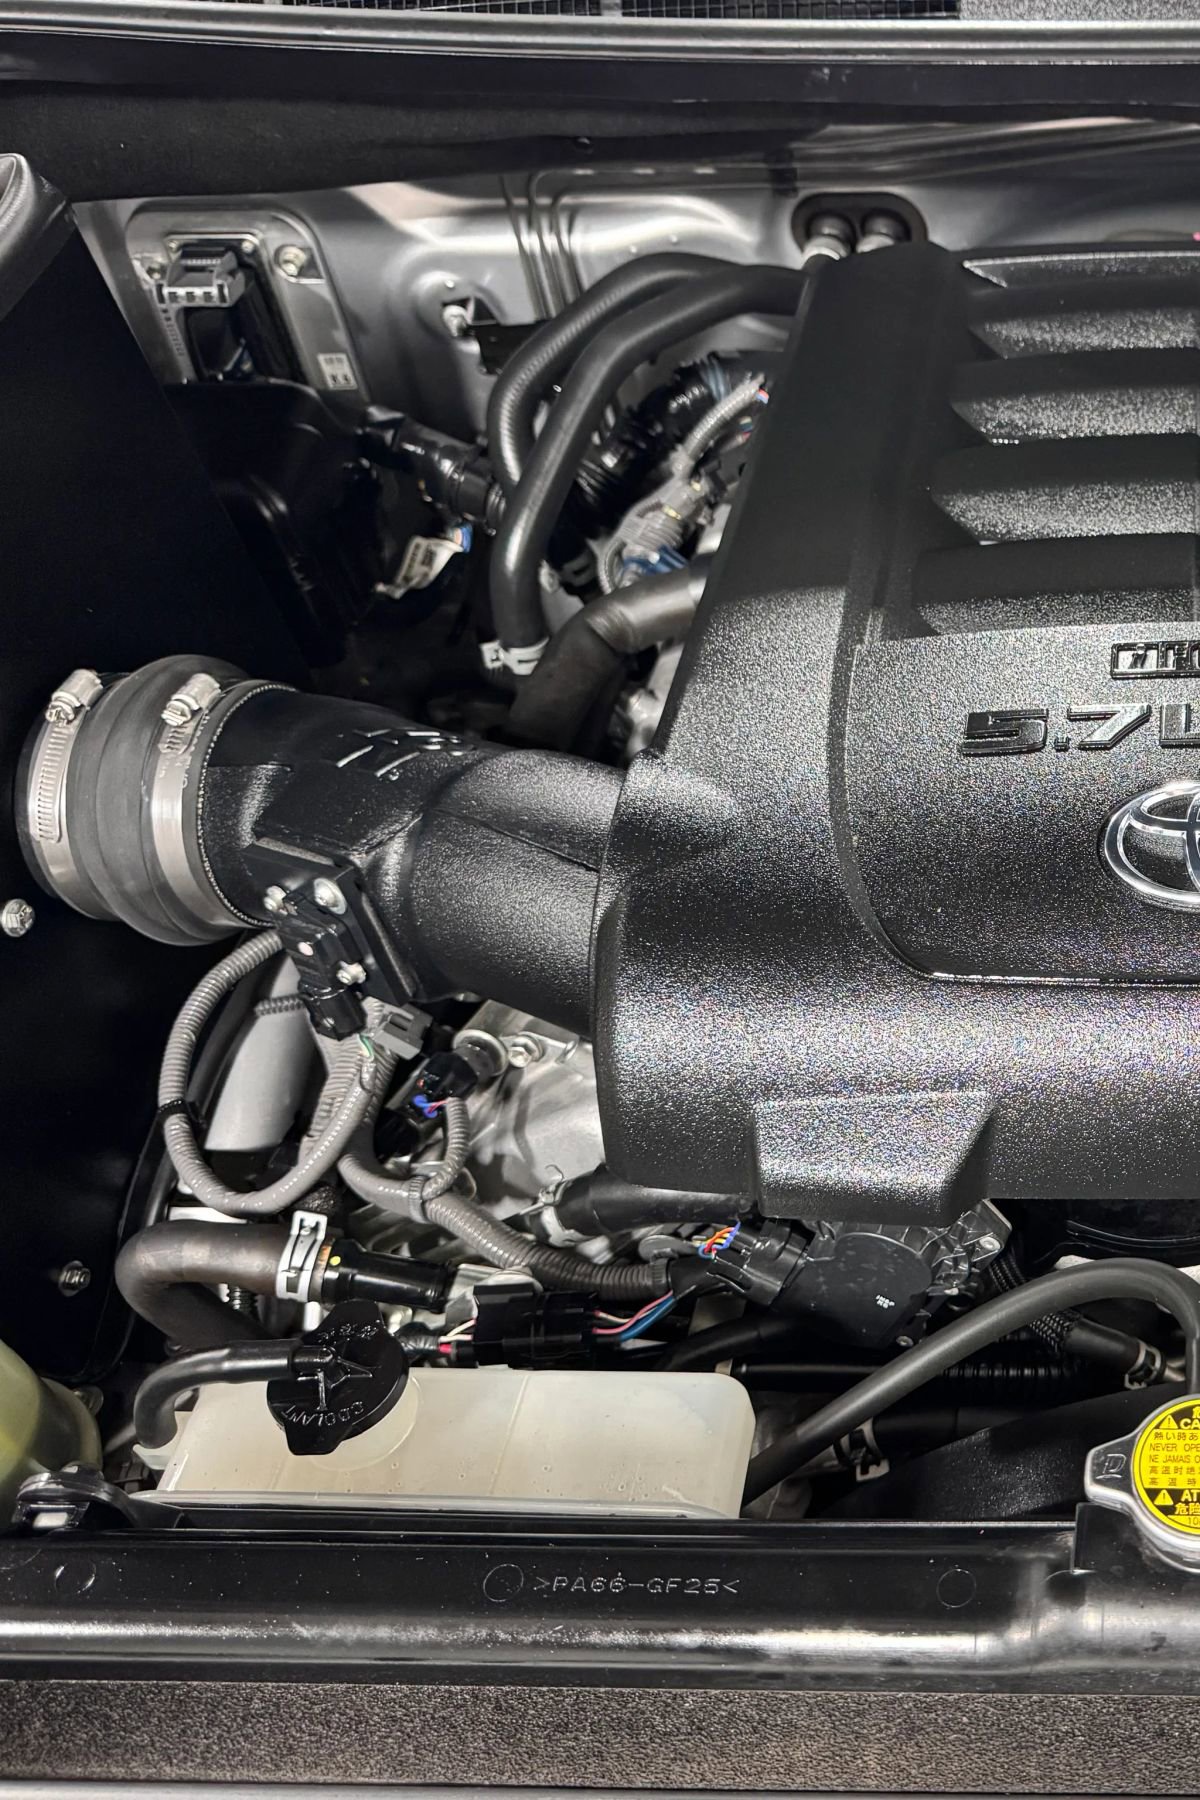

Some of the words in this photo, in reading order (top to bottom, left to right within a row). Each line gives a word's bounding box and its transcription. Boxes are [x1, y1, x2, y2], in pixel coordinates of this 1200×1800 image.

[281, 1401, 364, 1427] COOLANT
[1149, 1443, 1178, 1452] NEVER
[1149, 1454, 1160, 1463] NE
[1162, 1454, 1191, 1463] JAMAIS
